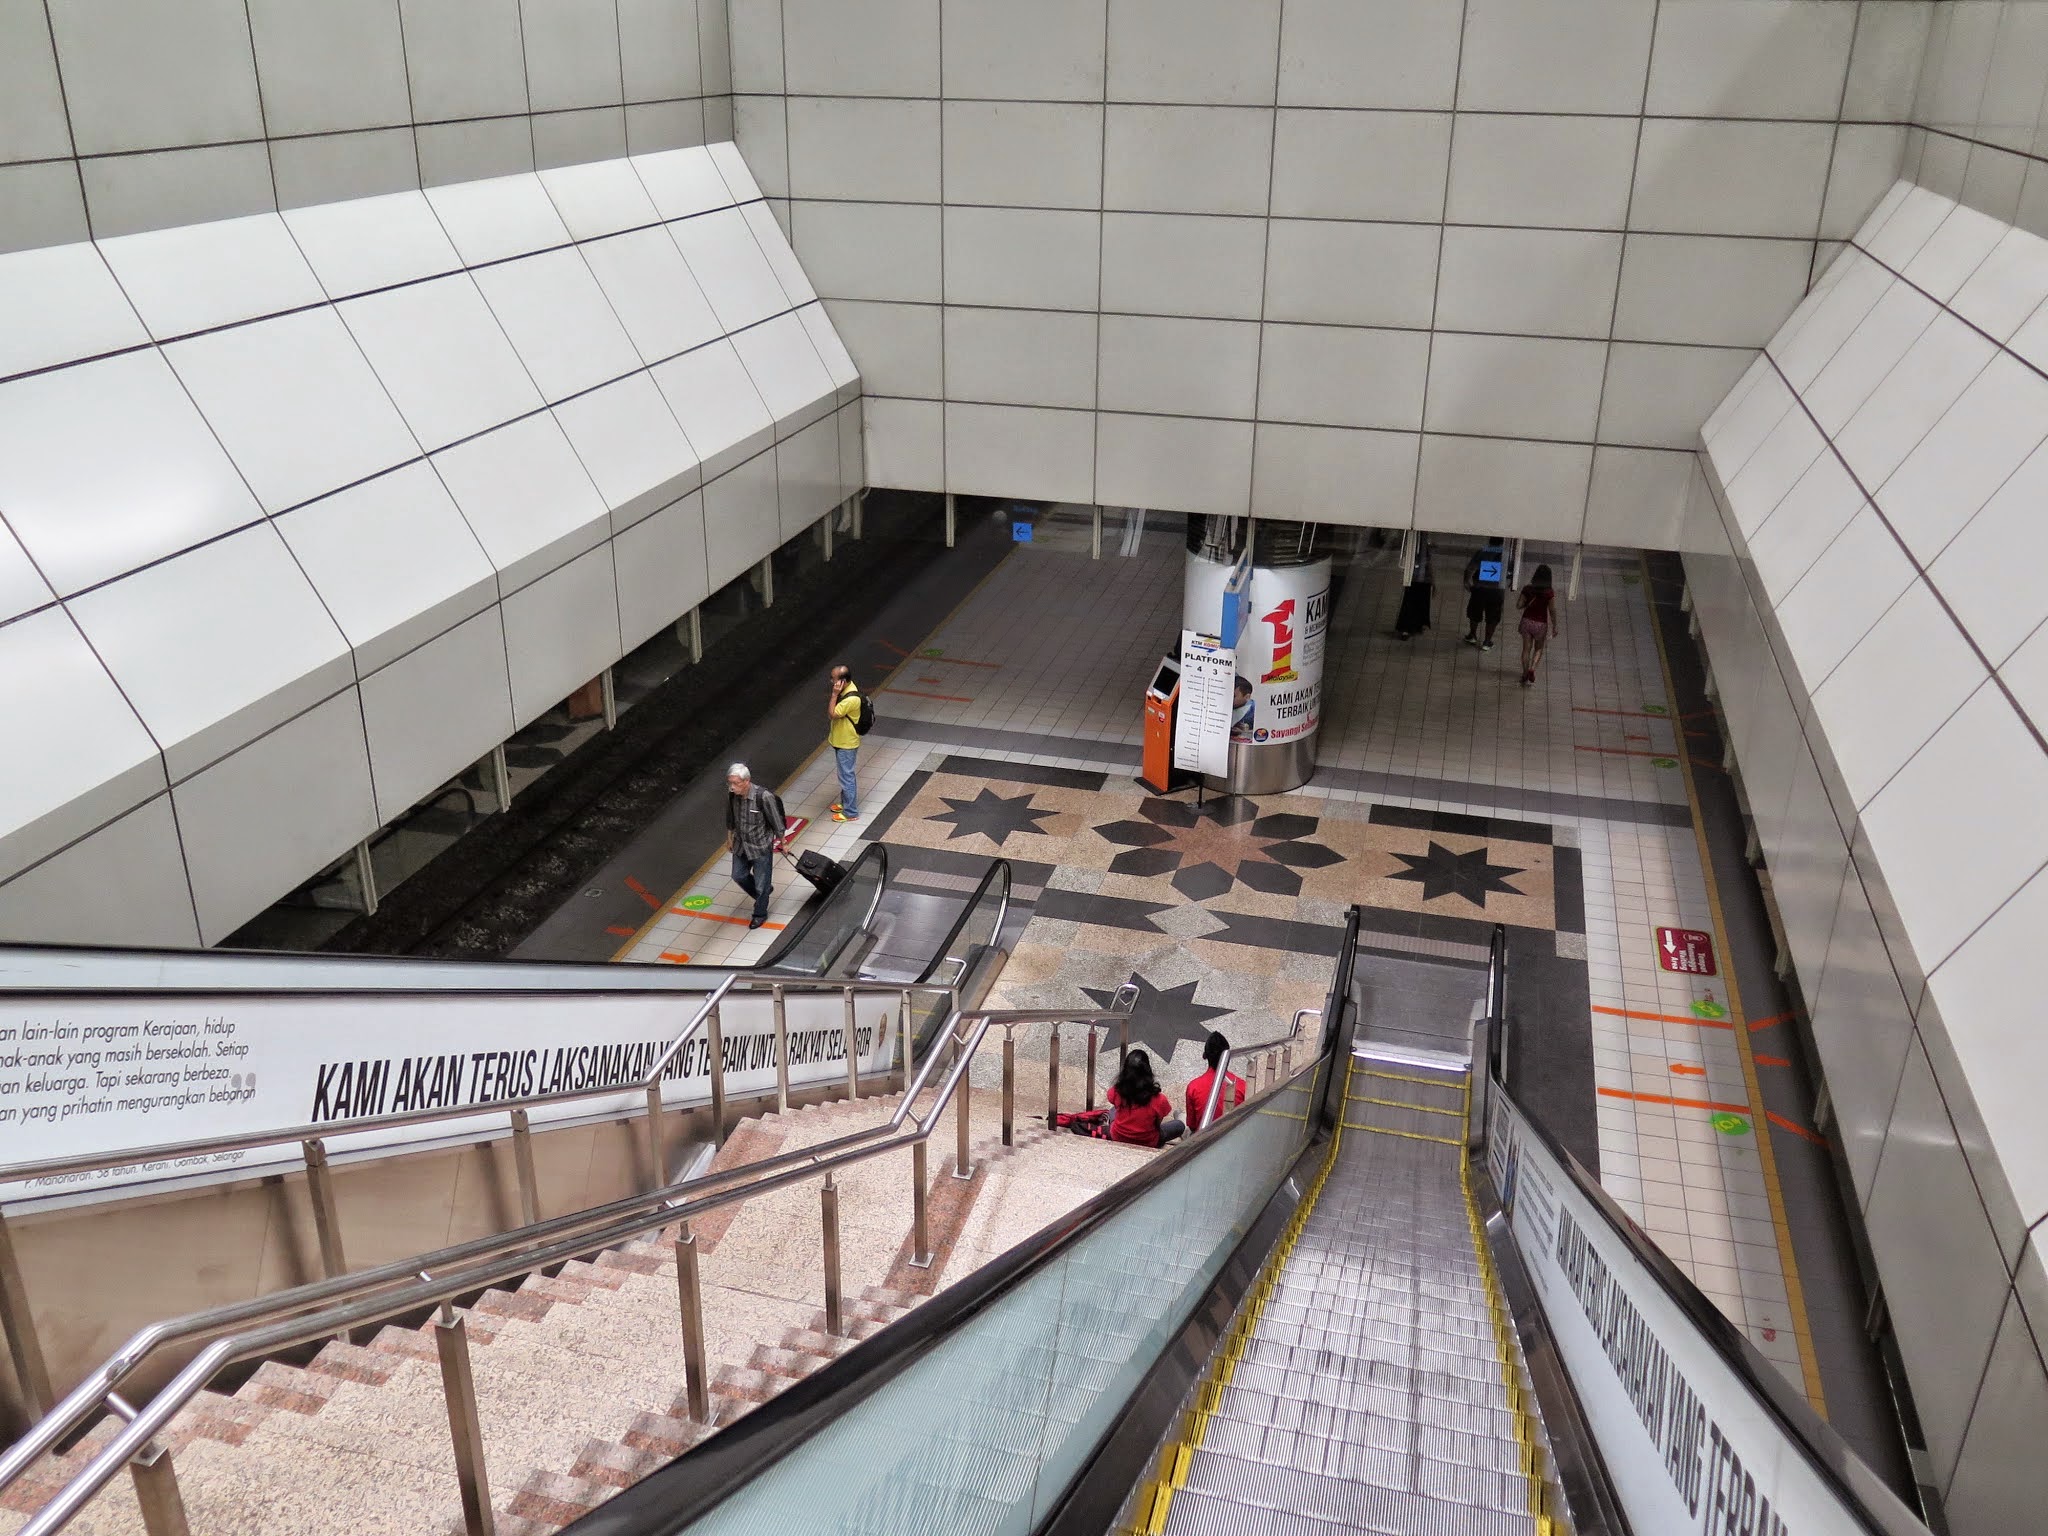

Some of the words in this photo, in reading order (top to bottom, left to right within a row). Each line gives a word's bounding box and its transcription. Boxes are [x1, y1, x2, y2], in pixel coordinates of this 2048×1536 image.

[1184, 652, 1233, 668] PLATFORM
[1196, 665, 1203, 673] 4
[1212, 668, 1218, 676] 3
[1270, 691, 1293, 707] KAMI
[1295, 686, 1313, 703] AKAN
[1276, 701, 1309, 719] TERBAIK
[1270, 725, 1301, 739] Sayangi
[1671, 956, 1679, 970] Area
[1679, 949, 1688, 971] Waiting
[22, 1020, 79, 1041] lain-lain
[82, 1023, 140, 1044] program
[143, 1019, 201, 1041] Kerajaan,
[204, 1016, 236, 1038] hidup
[66, 1050, 101, 1070] yang
[105, 1042, 142, 1063] masih
[146, 1040, 211, 1061] bersekolah.
[216, 1039, 249, 1062] Setiap
[25, 1072, 89, 1096] keluarga.
[96, 1071, 121, 1093] Tapi
[125, 1066, 180, 1089] sekarang
[183, 1063, 231, 1082] berbeza.
[311, 1059, 391, 1122] KAMI
[391, 1054, 465, 1113] AKAN
[468, 1049, 537, 1103] TERUS
[697, 1034, 752, 1077] TEBAIK
[787, 1029, 829, 1066] RAKYAT
[826, 1026, 872, 1061] SELAGOR
[21, 1104, 58, 1126] yang
[60, 1095, 113, 1121] prihatin
[116, 1087, 205, 1114] mengurangkan
[208, 1083, 256, 1103] bebanan
[1582, 1240, 1608, 1341] TERUS
[1601, 1270, 1670, 1454] LAKSANAKAN
[1664, 1361, 1707, 1521] YANG
